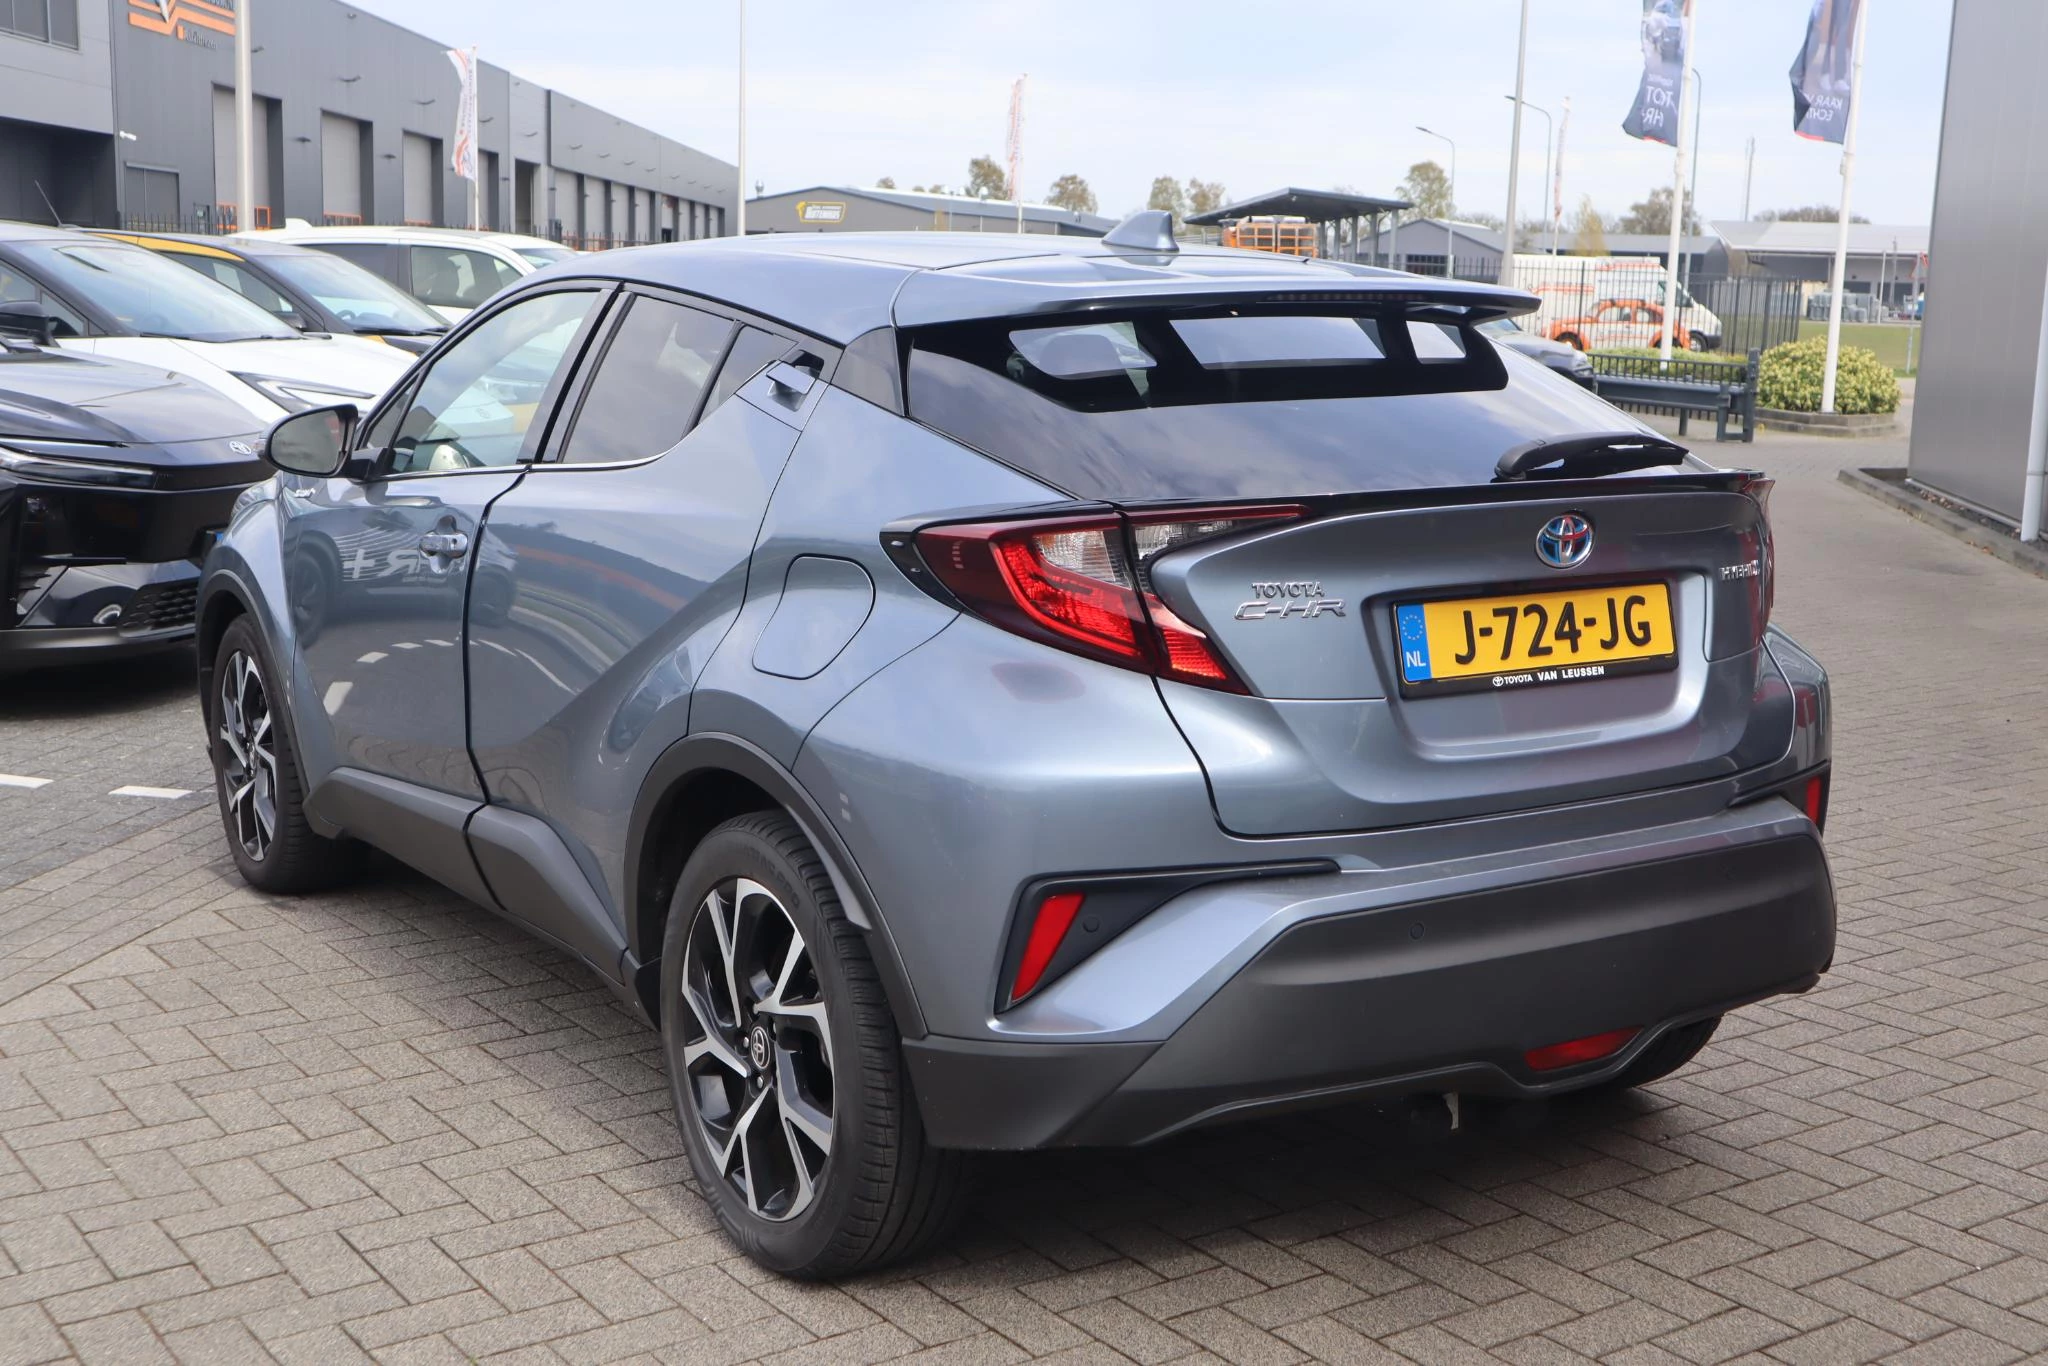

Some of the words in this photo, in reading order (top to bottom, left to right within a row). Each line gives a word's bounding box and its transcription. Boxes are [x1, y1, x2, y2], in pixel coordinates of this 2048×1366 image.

[1252, 581, 1325, 599] TOYOTA
[1234, 600, 1346, 620] C-HR
[1455, 595, 1652, 665] J-724-JG
[1406, 650, 1426, 669] NL
[1504, 674, 1534, 685] TOYOTA
[1537, 670, 1558, 681] VAN
[1562, 666, 1605, 679] LEUSSEN
